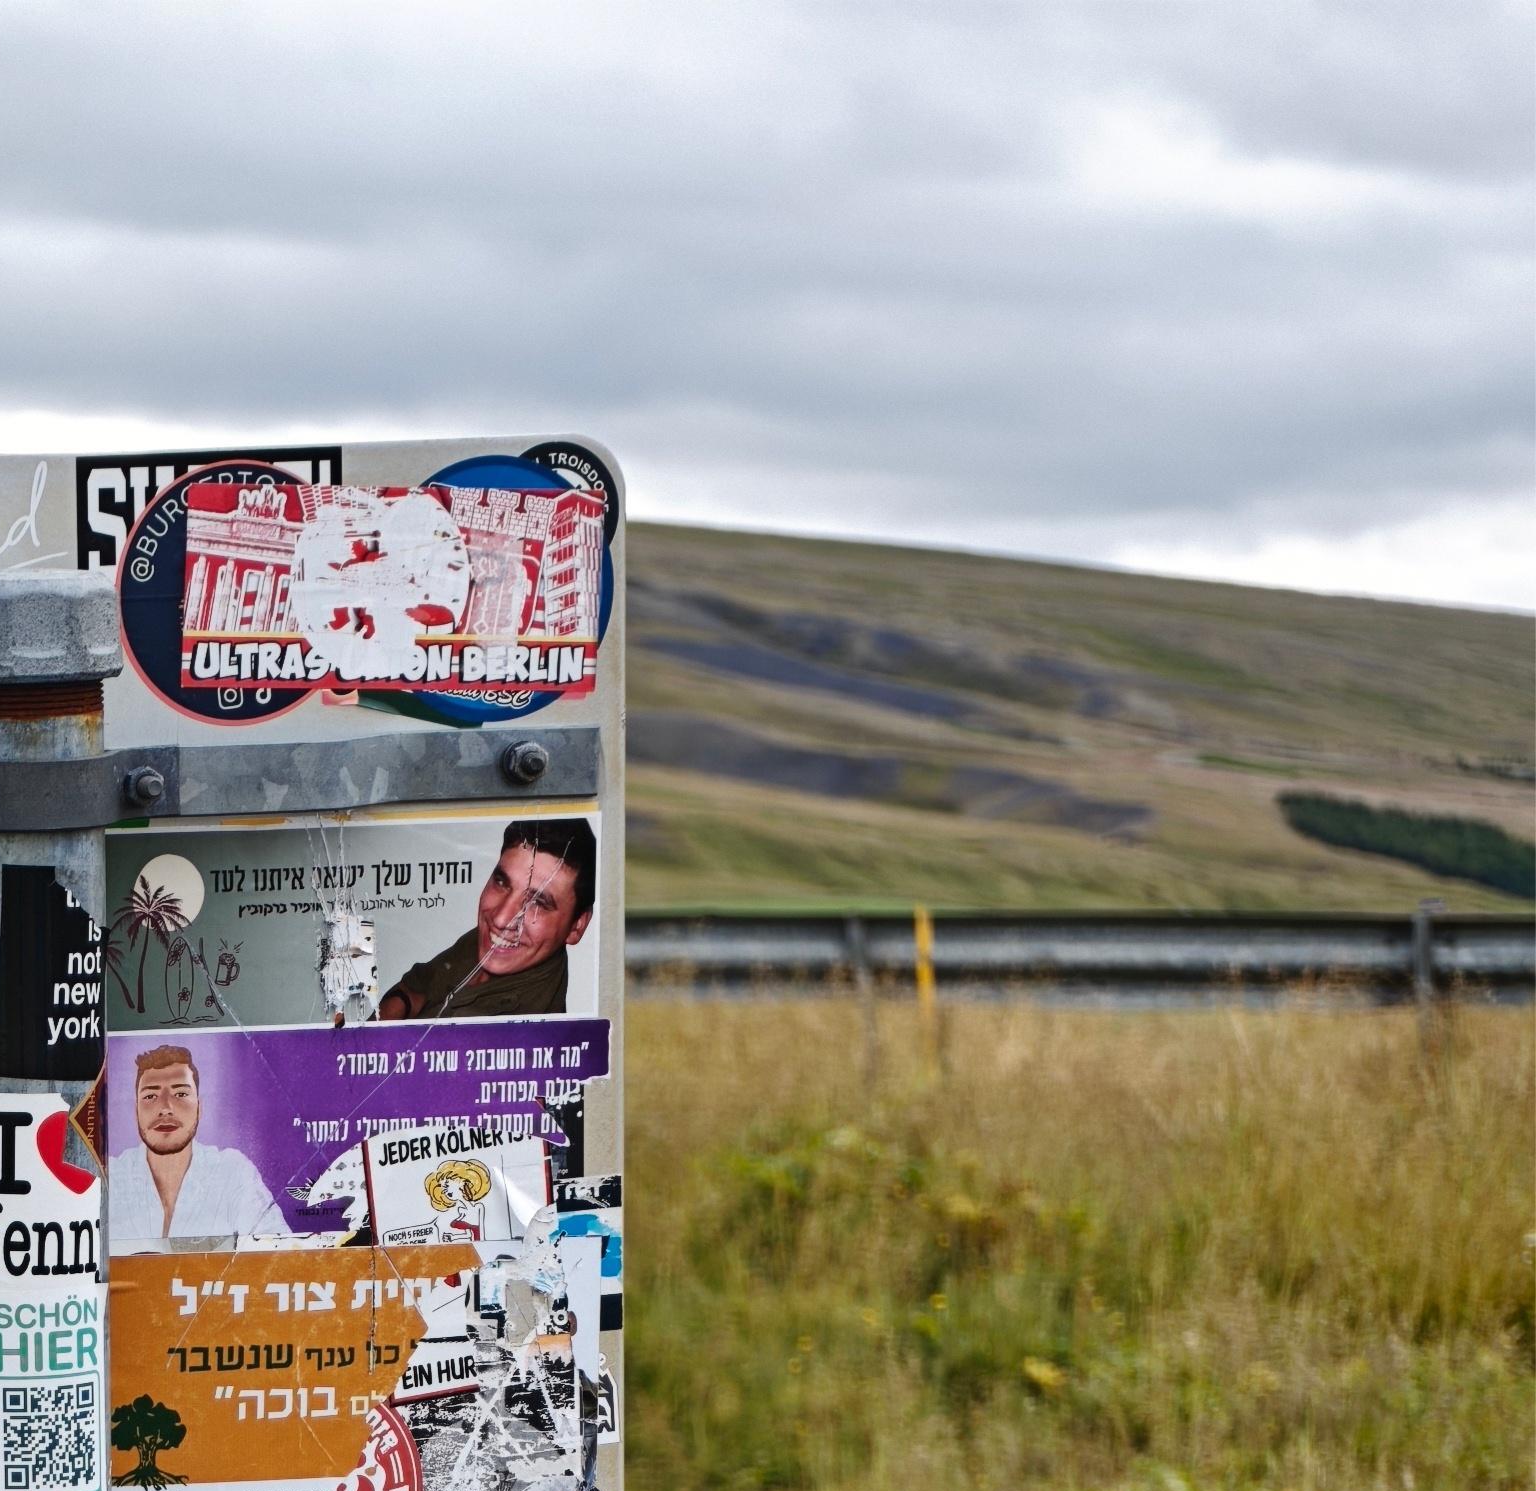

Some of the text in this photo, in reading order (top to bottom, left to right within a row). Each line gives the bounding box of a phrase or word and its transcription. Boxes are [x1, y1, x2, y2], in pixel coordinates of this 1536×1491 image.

[191, 641, 585, 684] ULTRAS BERLIN
[252, 859, 473, 895] החיוך שלך איתנו
[67, 946, 102, 976] not
[53, 982, 101, 1005] new
[47, 1014, 101, 1046] york
[423, 1050, 459, 1072] שאני
[531, 1047, 554, 1070] את
[378, 1139, 432, 1167] JEDER
[166, 1343, 294, 1373] שנשבר
[402, 1362, 433, 1390] EIN
